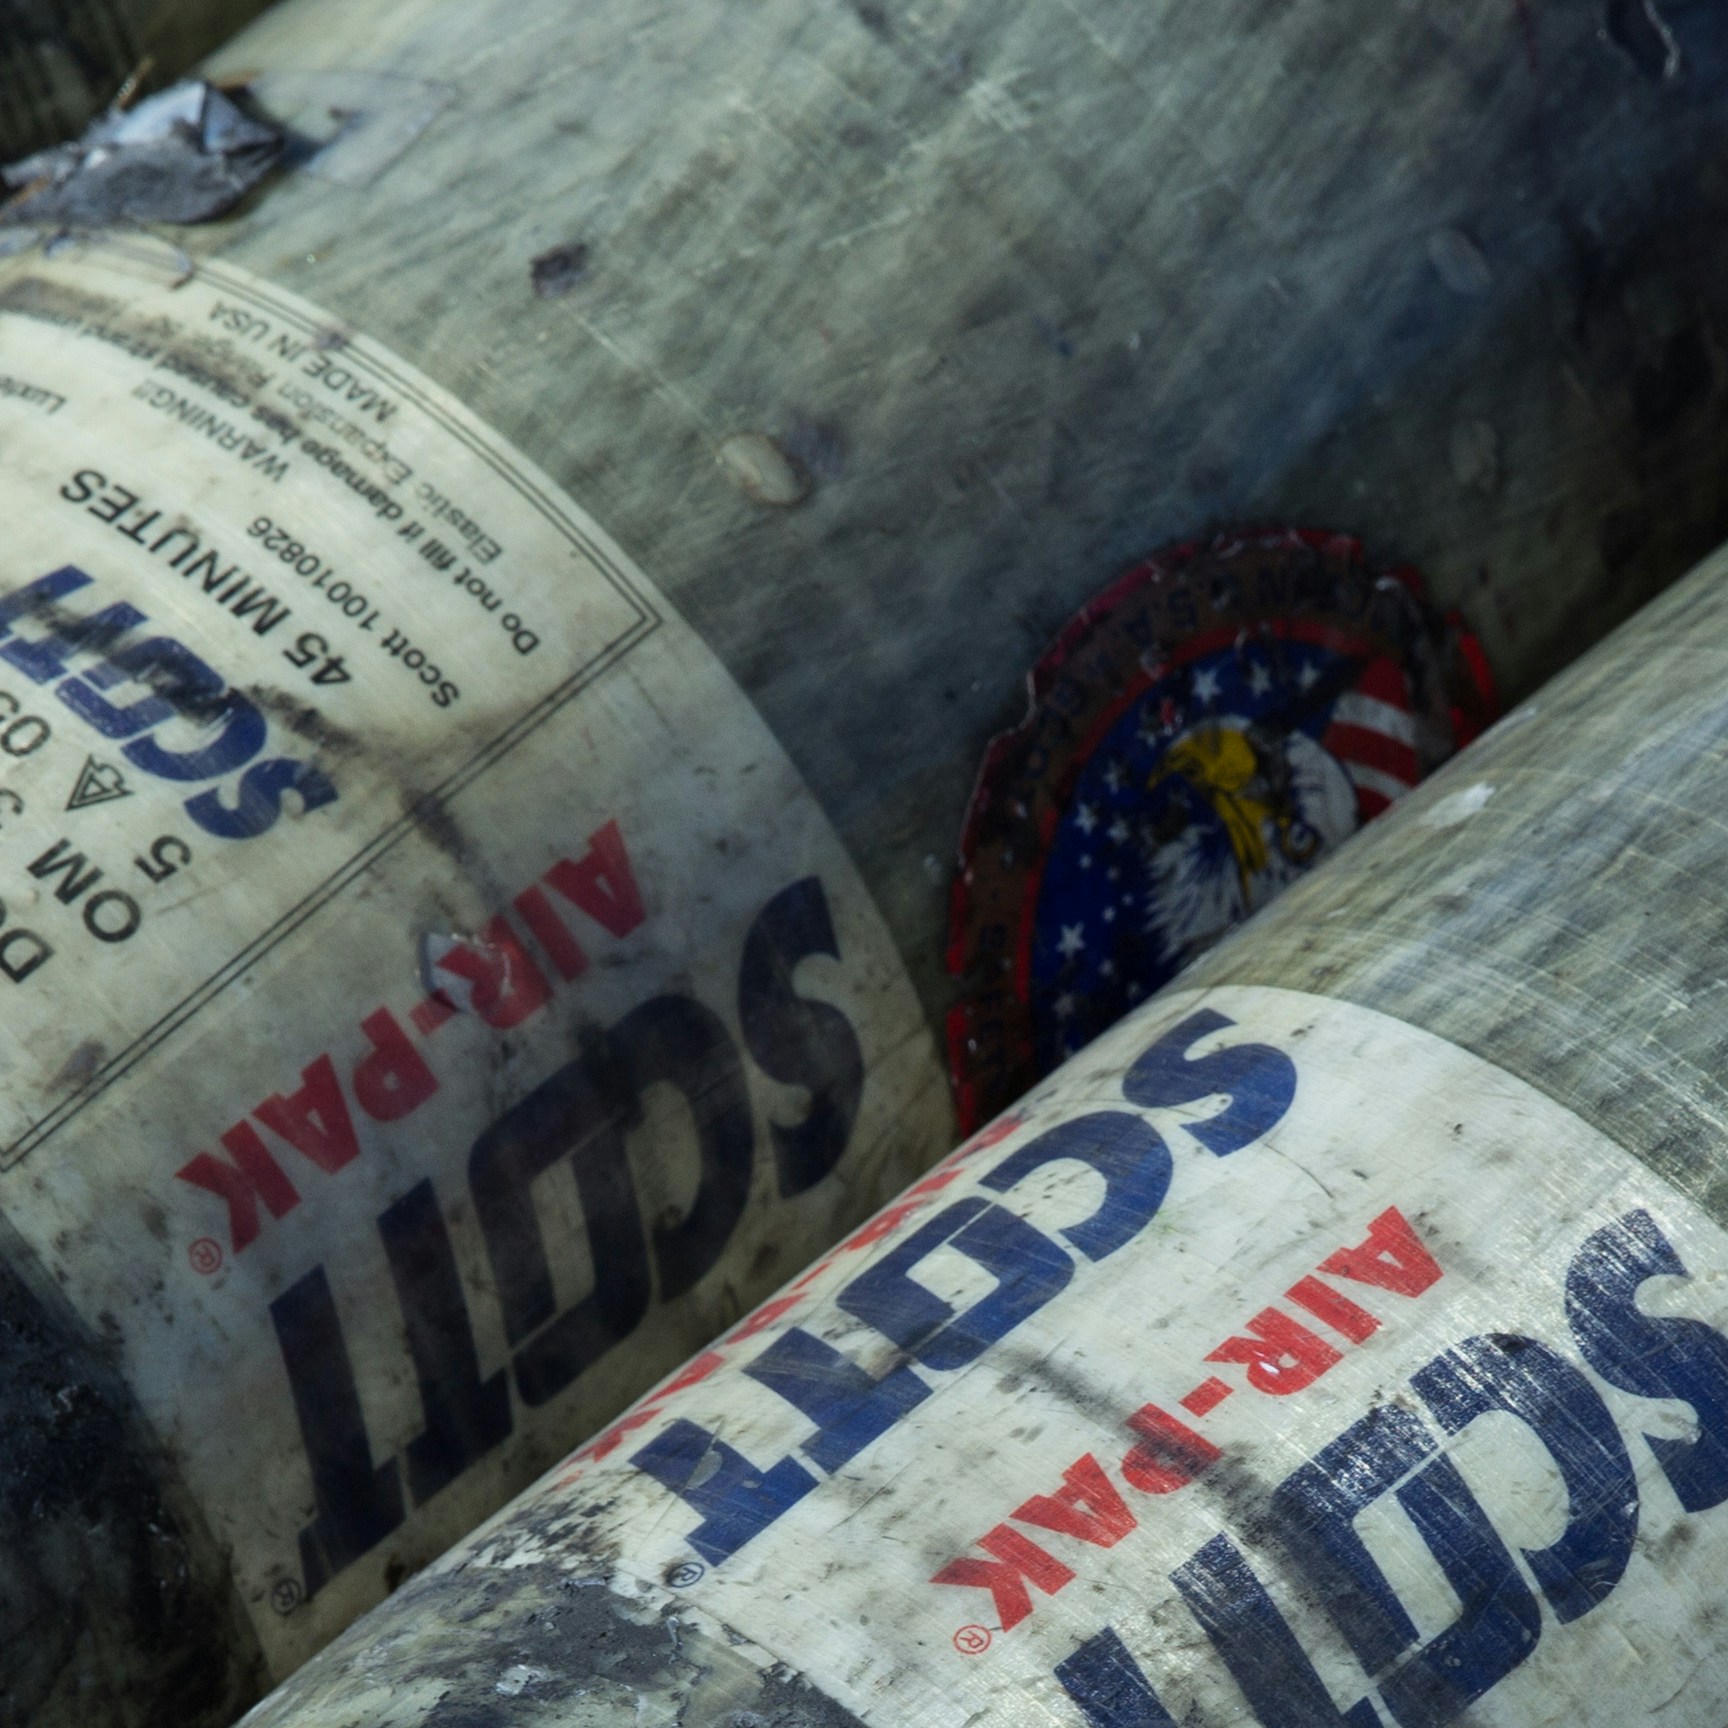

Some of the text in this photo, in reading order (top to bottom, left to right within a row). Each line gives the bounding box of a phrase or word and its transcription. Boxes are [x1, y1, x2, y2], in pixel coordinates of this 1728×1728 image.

[209, 301, 274, 341] USA
[129, 378, 290, 485] WARNING!!
[298, 434, 406, 524] damage
[58, 468, 352, 691] 45 MINUTES
[396, 513, 422, 544] if
[423, 530, 464, 573] fill
[247, 514, 460, 708] Scott 10010826
[458, 563, 502, 614] not
[499, 612, 541, 657] Do
[27, 838, 142, 945] OM
[133, 834, 192, 884] 5
[176, 819, 650, 1256] AIR-PAK
[269, 874, 867, 1602] SCOTT
[628, 1008, 1298, 1569] SCOTT
[928, 1205, 1444, 1633] AIR-PAK
